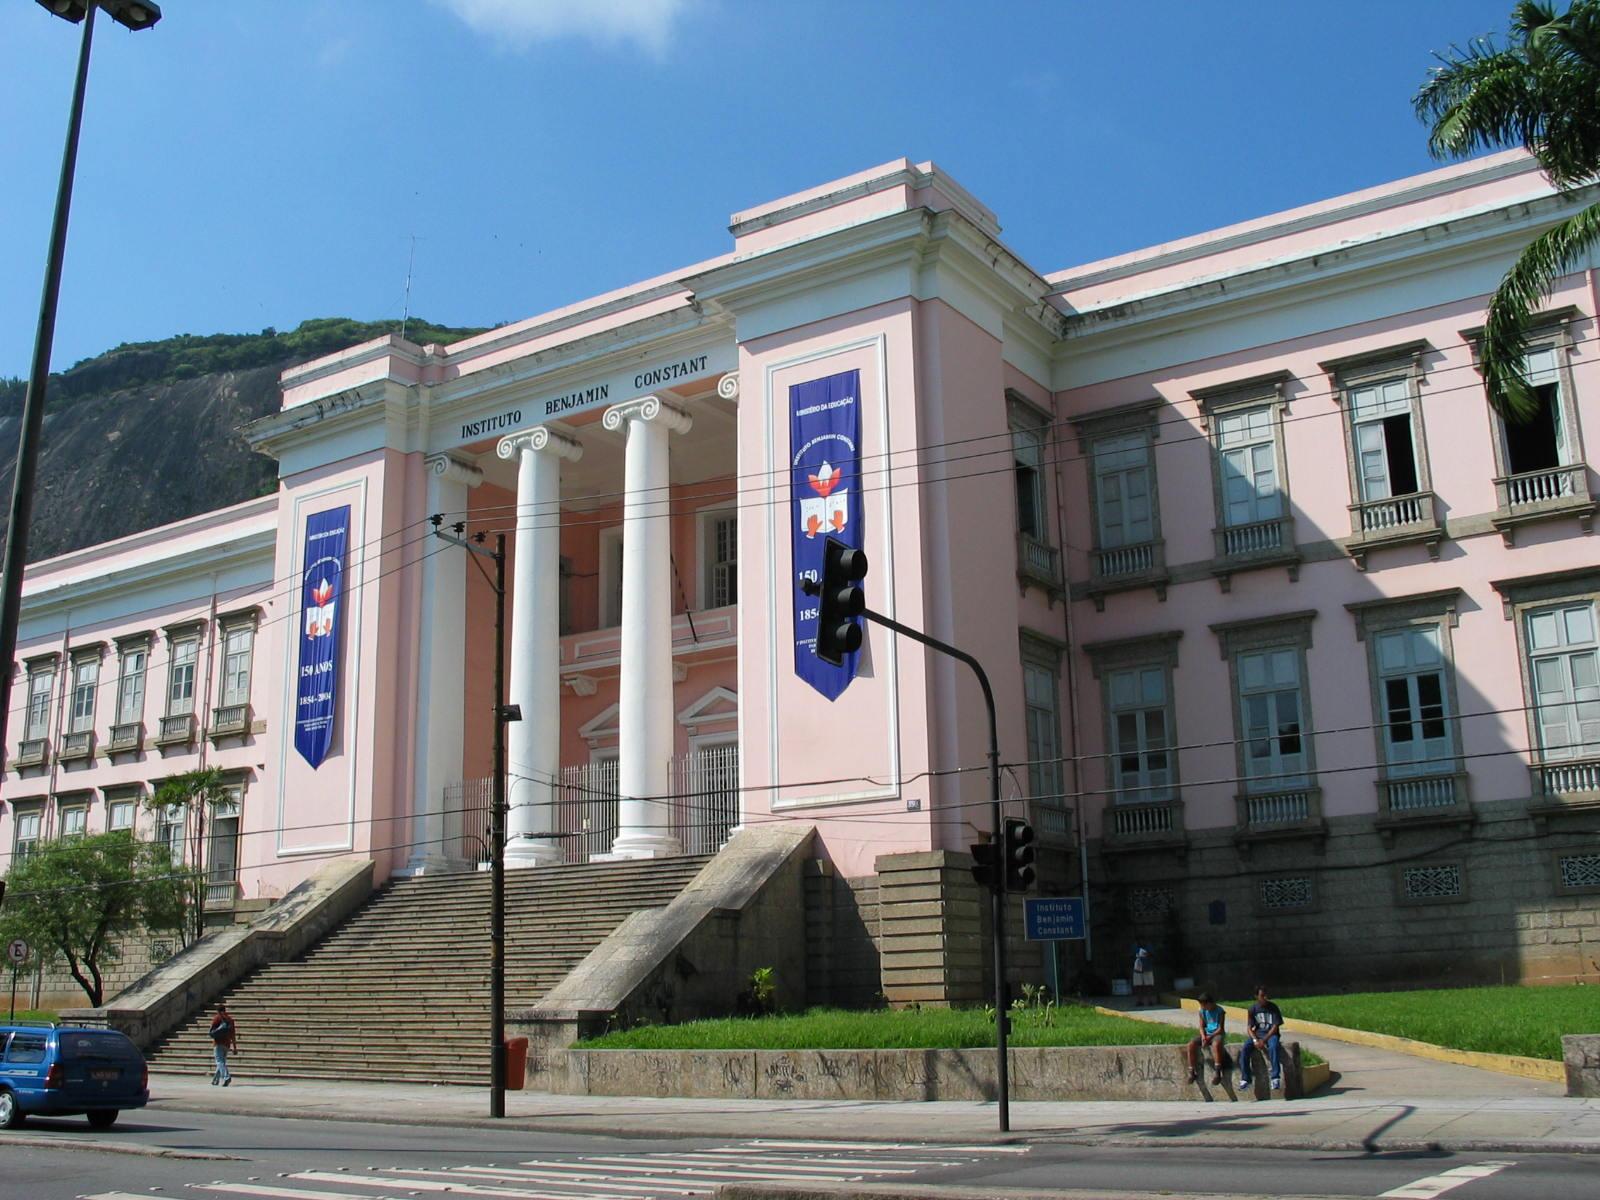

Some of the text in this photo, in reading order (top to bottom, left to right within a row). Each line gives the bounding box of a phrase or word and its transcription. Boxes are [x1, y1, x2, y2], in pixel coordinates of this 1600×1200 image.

[461, 356, 708, 438] INSTITUTO BENJAMIN CONSTANT
[301, 659, 333, 677] 150 ANOS
[1036, 903, 1072, 912] Instituto
[1036, 914, 1073, 924] Benjamin
[1037, 926, 1073, 935] Constant
